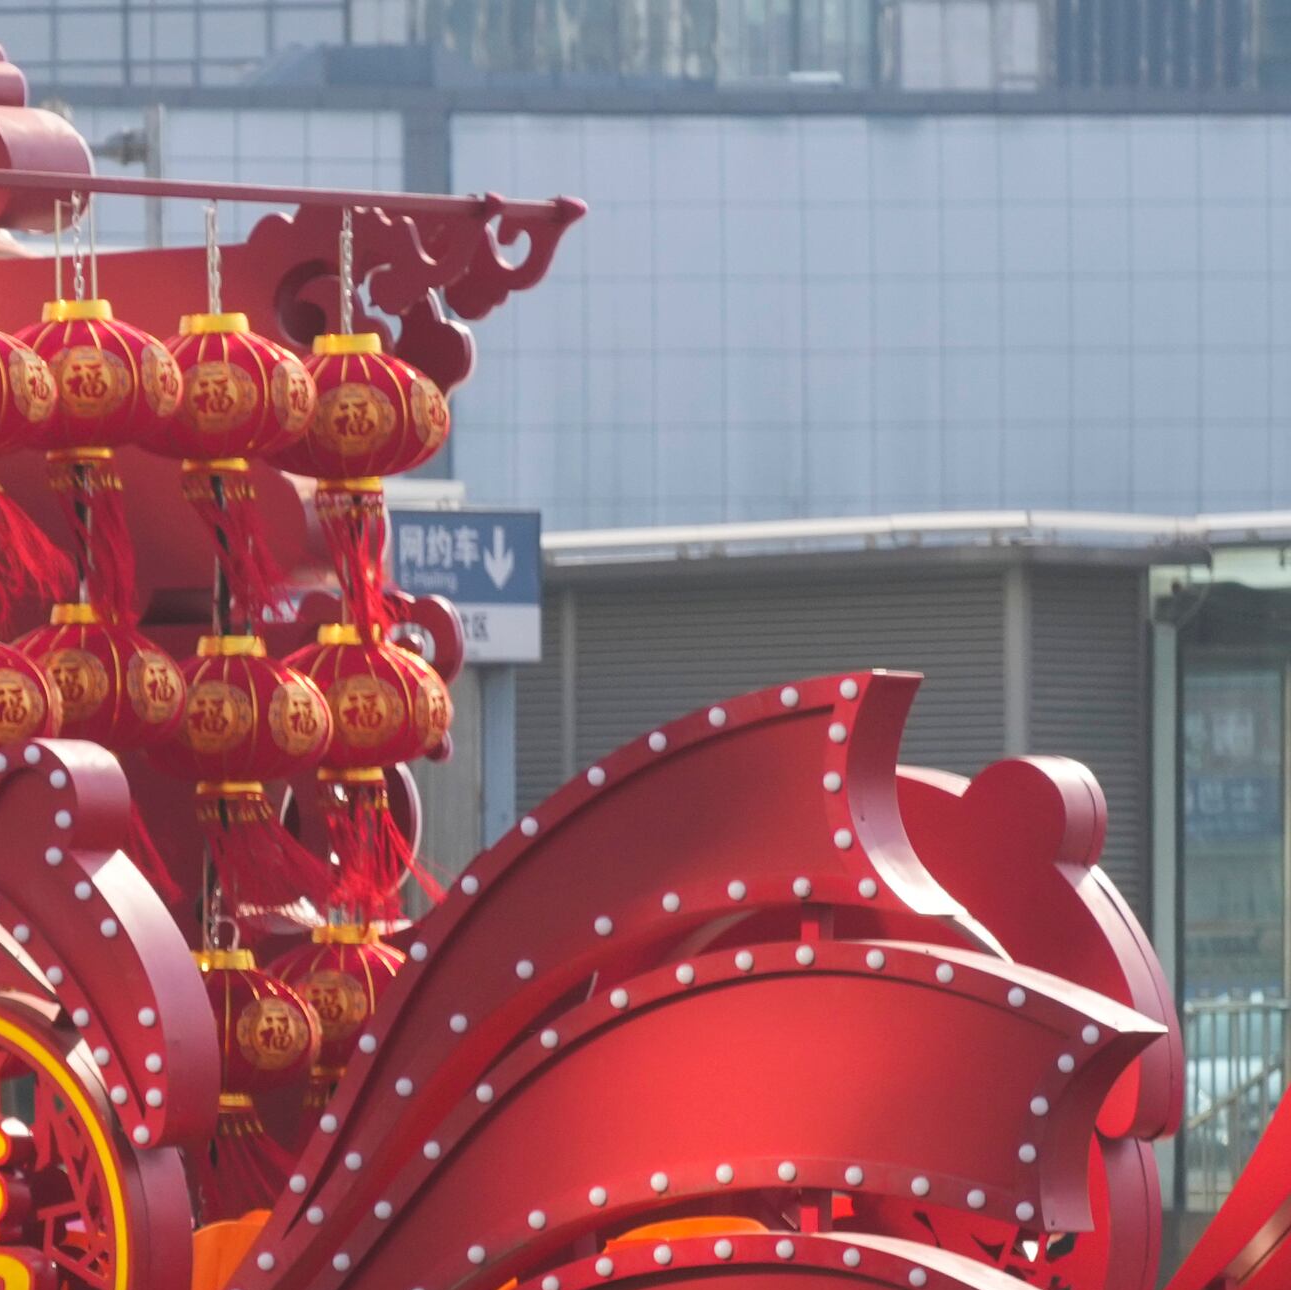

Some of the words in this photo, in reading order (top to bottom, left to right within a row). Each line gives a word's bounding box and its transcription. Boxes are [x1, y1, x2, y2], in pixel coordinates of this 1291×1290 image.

[65, 362, 108, 399] 福
[193, 376, 235, 414] 福
[334, 401, 375, 436] 福
[399, 524, 479, 569] 网约车
[188, 699, 228, 732] 福
[342, 693, 383, 729] 福
[260, 1017, 293, 1050] 福
